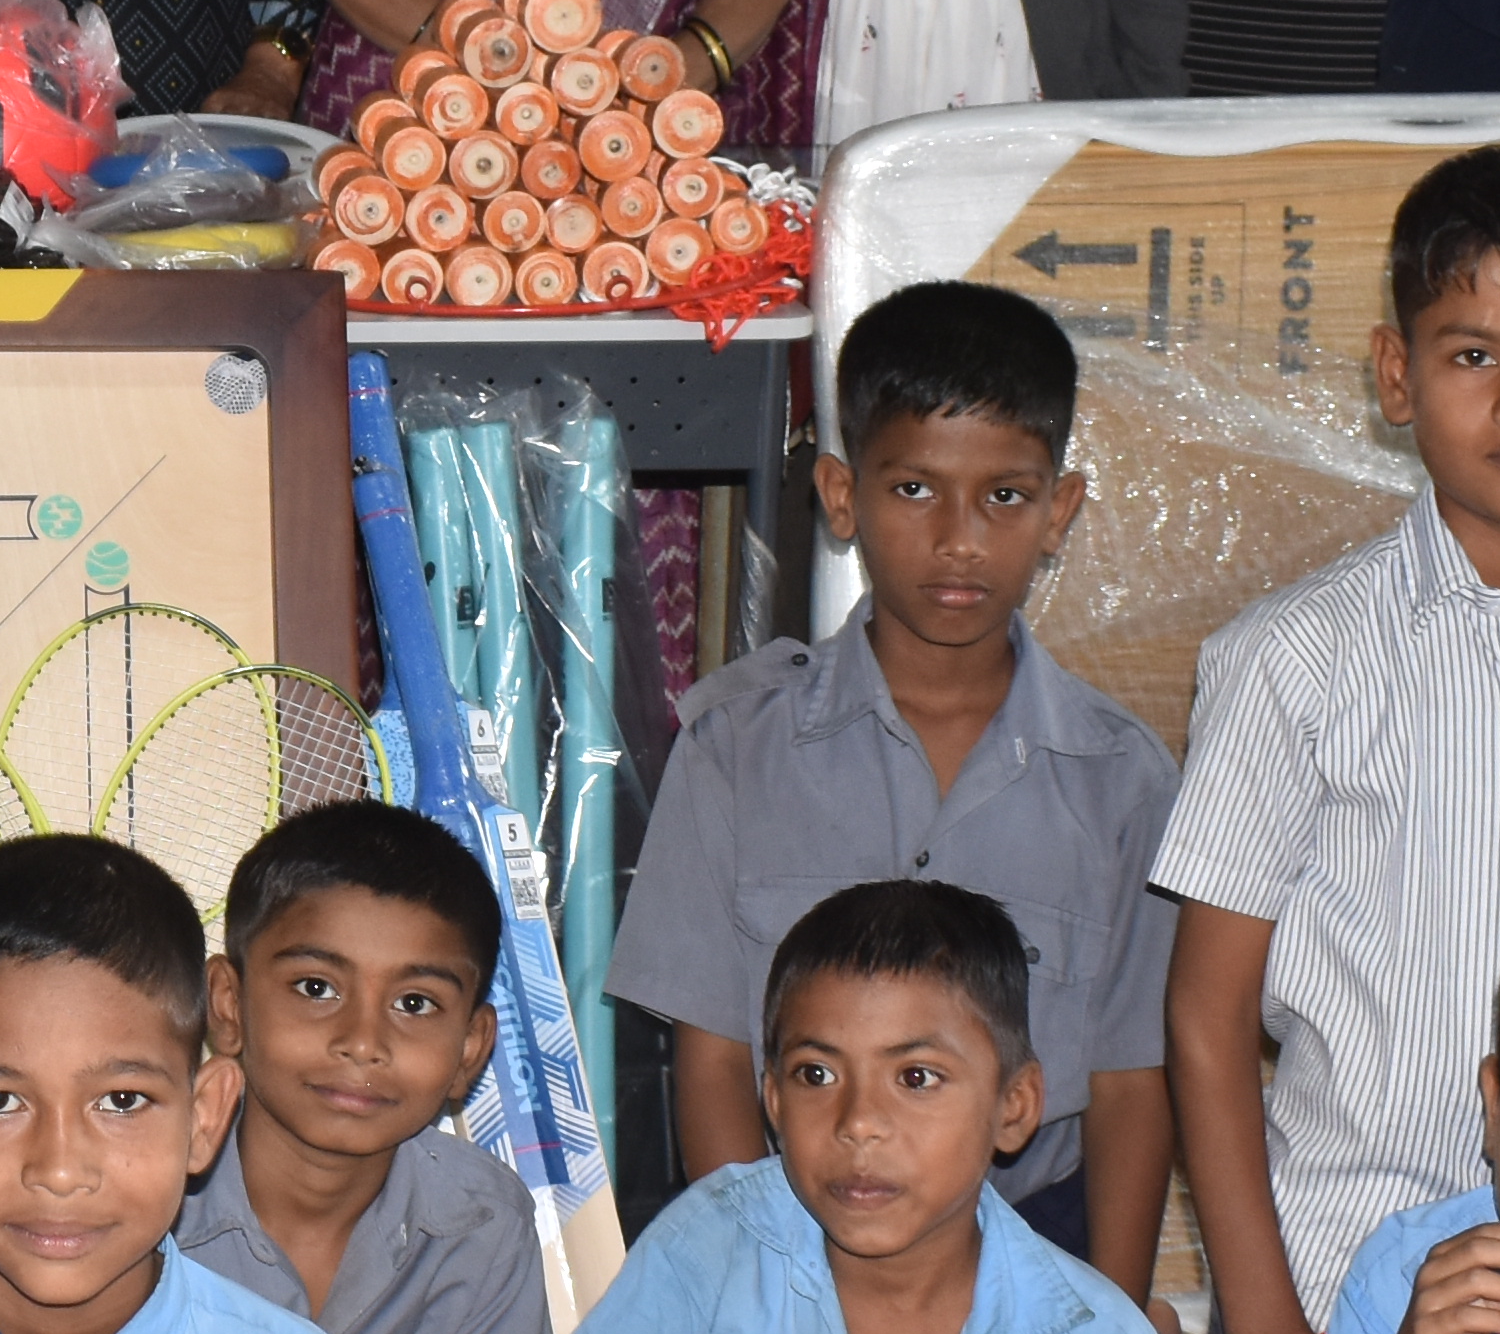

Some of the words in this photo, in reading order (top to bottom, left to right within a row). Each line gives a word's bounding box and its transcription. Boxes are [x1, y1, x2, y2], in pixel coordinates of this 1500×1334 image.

[1189, 235, 1206, 288] SIDE
[1211, 274, 1226, 306] UP
[1278, 204, 1316, 374] FRONT
[477, 718, 486, 738] 6
[507, 822, 518, 842] 5
